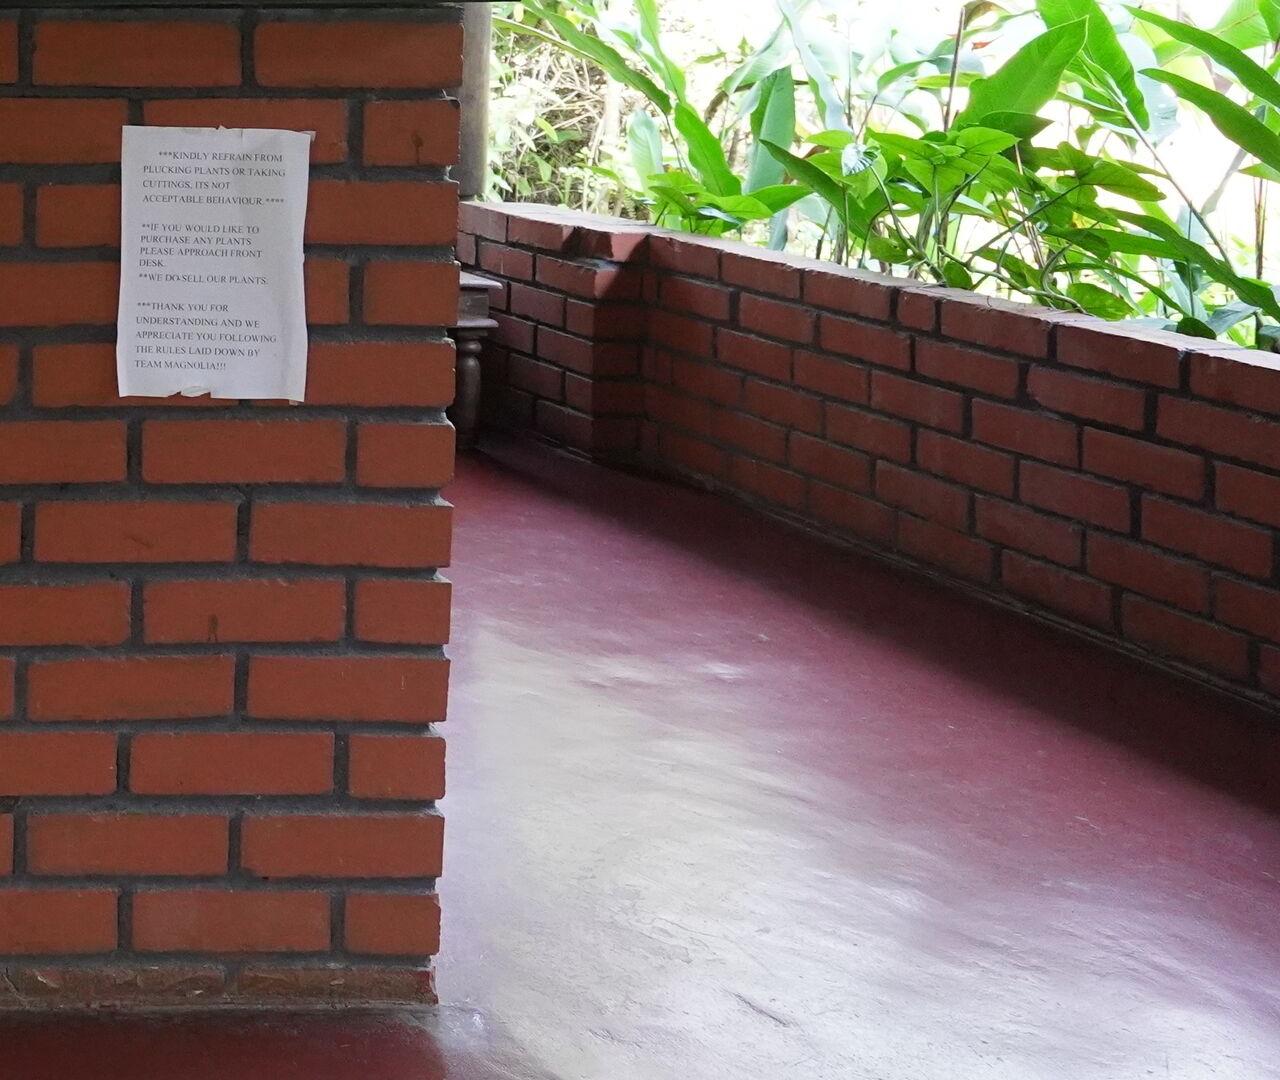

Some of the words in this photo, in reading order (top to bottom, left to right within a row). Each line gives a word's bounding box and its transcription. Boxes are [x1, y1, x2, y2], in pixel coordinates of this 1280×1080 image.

[212, 152, 252, 161] REFRAIN
[255, 154, 283, 162] FROM
[144, 166, 191, 174] PLUCKING
[194, 167, 230, 175] PLANTS
[248, 168, 285, 177] TAKING
[142, 180, 192, 189] CUTTINGS,
[196, 181, 209, 189] ITS
[142, 195, 203, 203] ACCEPTABLE
[162, 224, 182, 232] YOU
[185, 225, 220, 233] WOULD
[246, 226, 259, 234] TO
[141, 236, 191, 244] PURCHASE
[216, 237, 251, 245] PLANTS
[140, 247, 174, 255] PLEASE
[178, 248, 228, 257] APPROACH
[230, 250, 263, 258] FRONT
[165, 274, 180, 282] DO
[182, 275, 204, 283] SELL
[136, 317, 218, 326] UNDERSTANDING
[221, 319, 242, 327] AND
[136, 331, 193, 340] APPRECIATE
[196, 333, 216, 341] YOU
[219, 334, 276, 343] FOLLOWING
[156, 345, 186, 354] RULES
[189, 347, 212, 355] LAID
[215, 348, 245, 356] DOWN
[135, 360, 161, 368] TEAM
[165, 361, 226, 370] MAGNOLIA!!!
